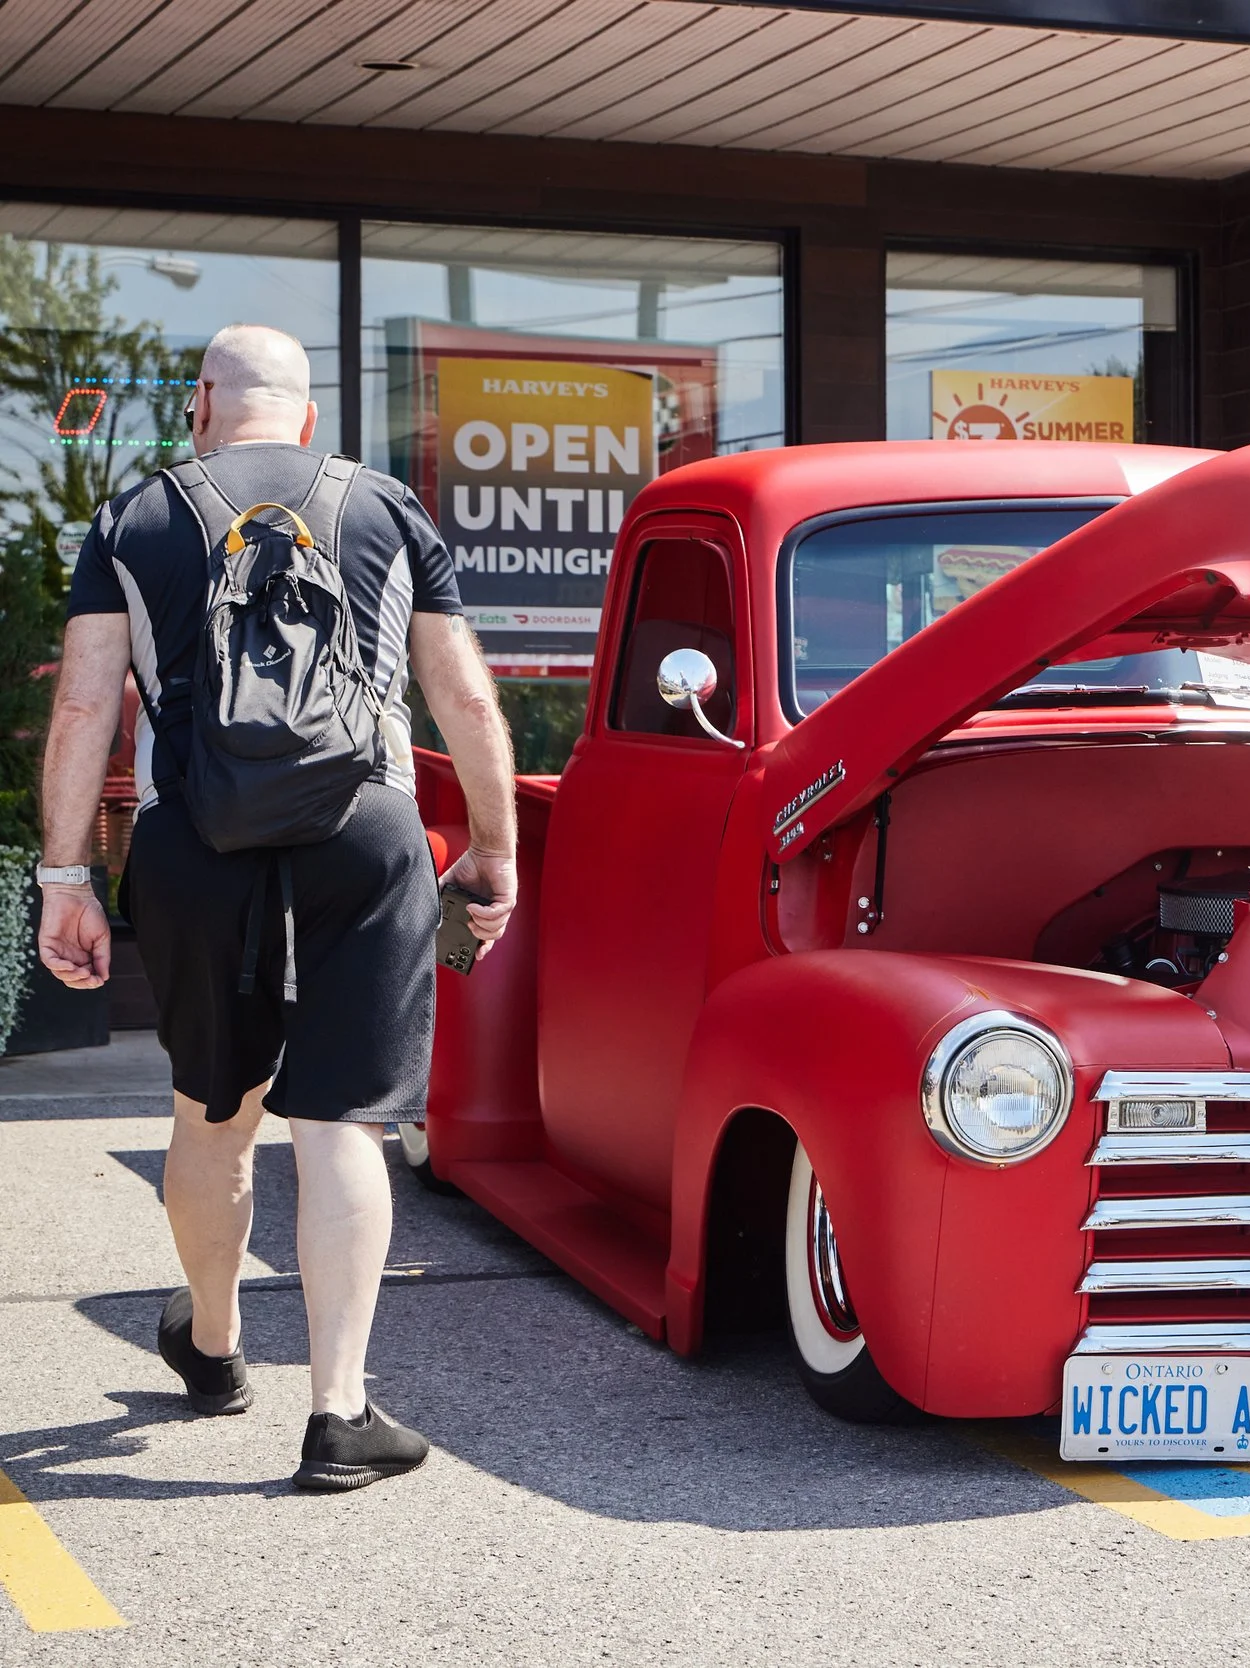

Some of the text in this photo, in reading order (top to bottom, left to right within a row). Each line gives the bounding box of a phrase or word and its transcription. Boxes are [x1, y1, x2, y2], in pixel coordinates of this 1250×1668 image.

[481, 378, 609, 398] HARVEY'S
[989, 377, 1081, 393] HARVEY'S
[1022, 421, 1125, 441] SUMMER
[453, 420, 640, 475] OPEN
[454, 545, 614, 575] MIDNIGH
[479, 614, 508, 624] Eats
[532, 616, 591, 624] DOORDASH
[1073, 1385, 1208, 1435] WICKED
[1115, 1439, 1207, 1447] YOURS TO DISCOVER
